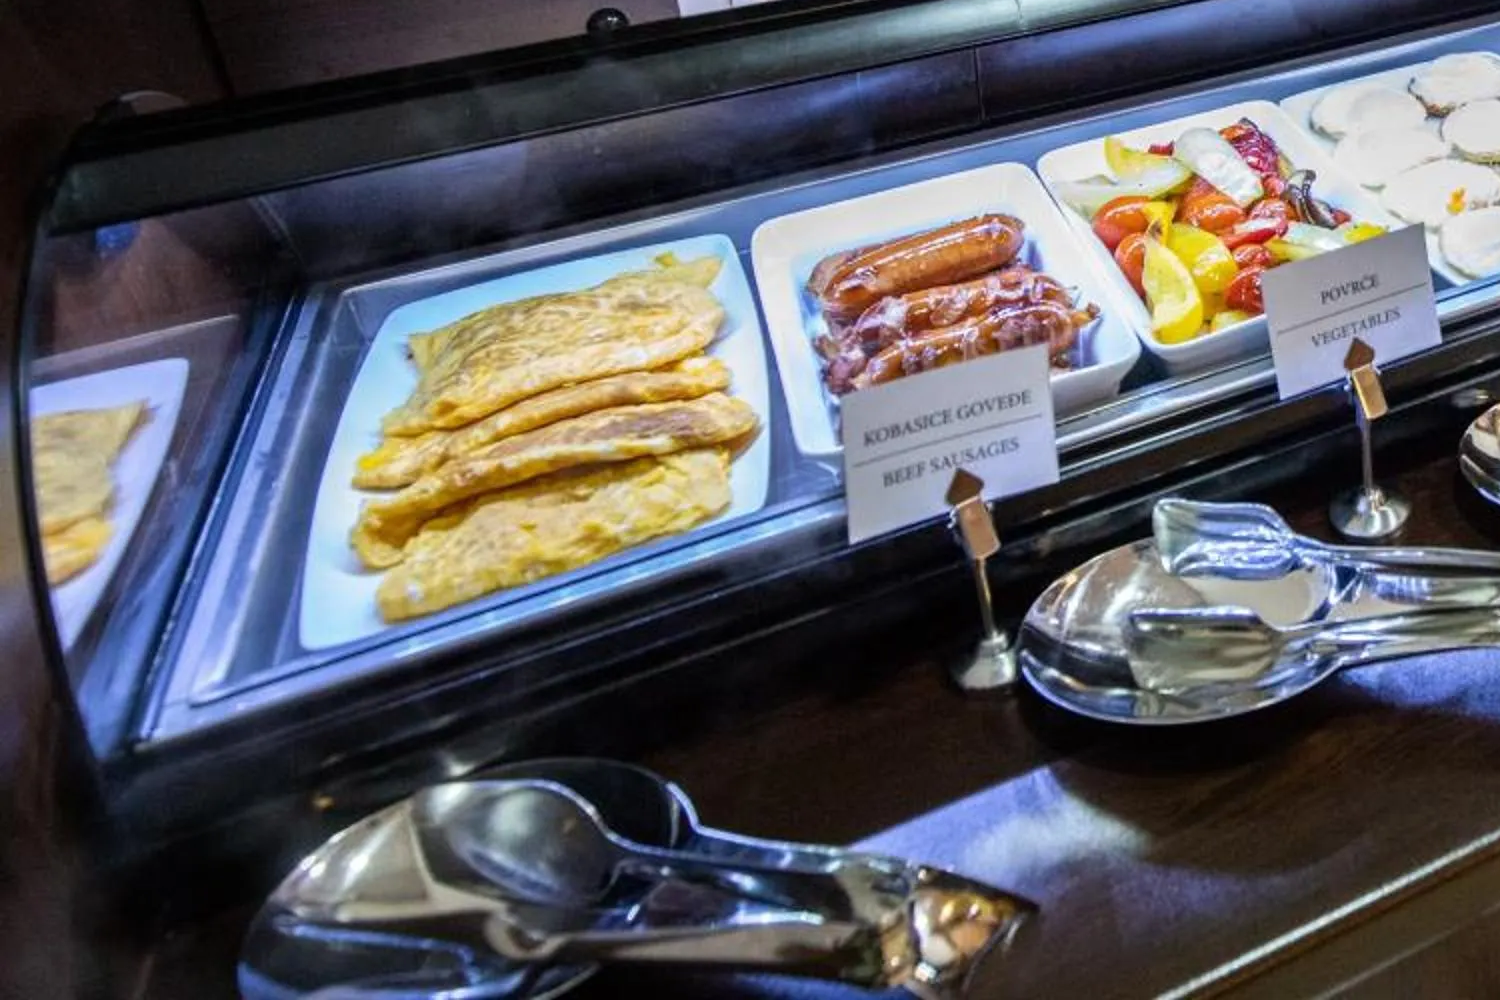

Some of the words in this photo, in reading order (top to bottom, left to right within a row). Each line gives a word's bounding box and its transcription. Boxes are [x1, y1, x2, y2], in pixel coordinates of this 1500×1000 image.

[1311, 306, 1402, 347] VEGETABLES
[863, 408, 953, 447] KOBASICE
[883, 461, 928, 488] BEEF
[930, 437, 1020, 473] SAUSAGES
